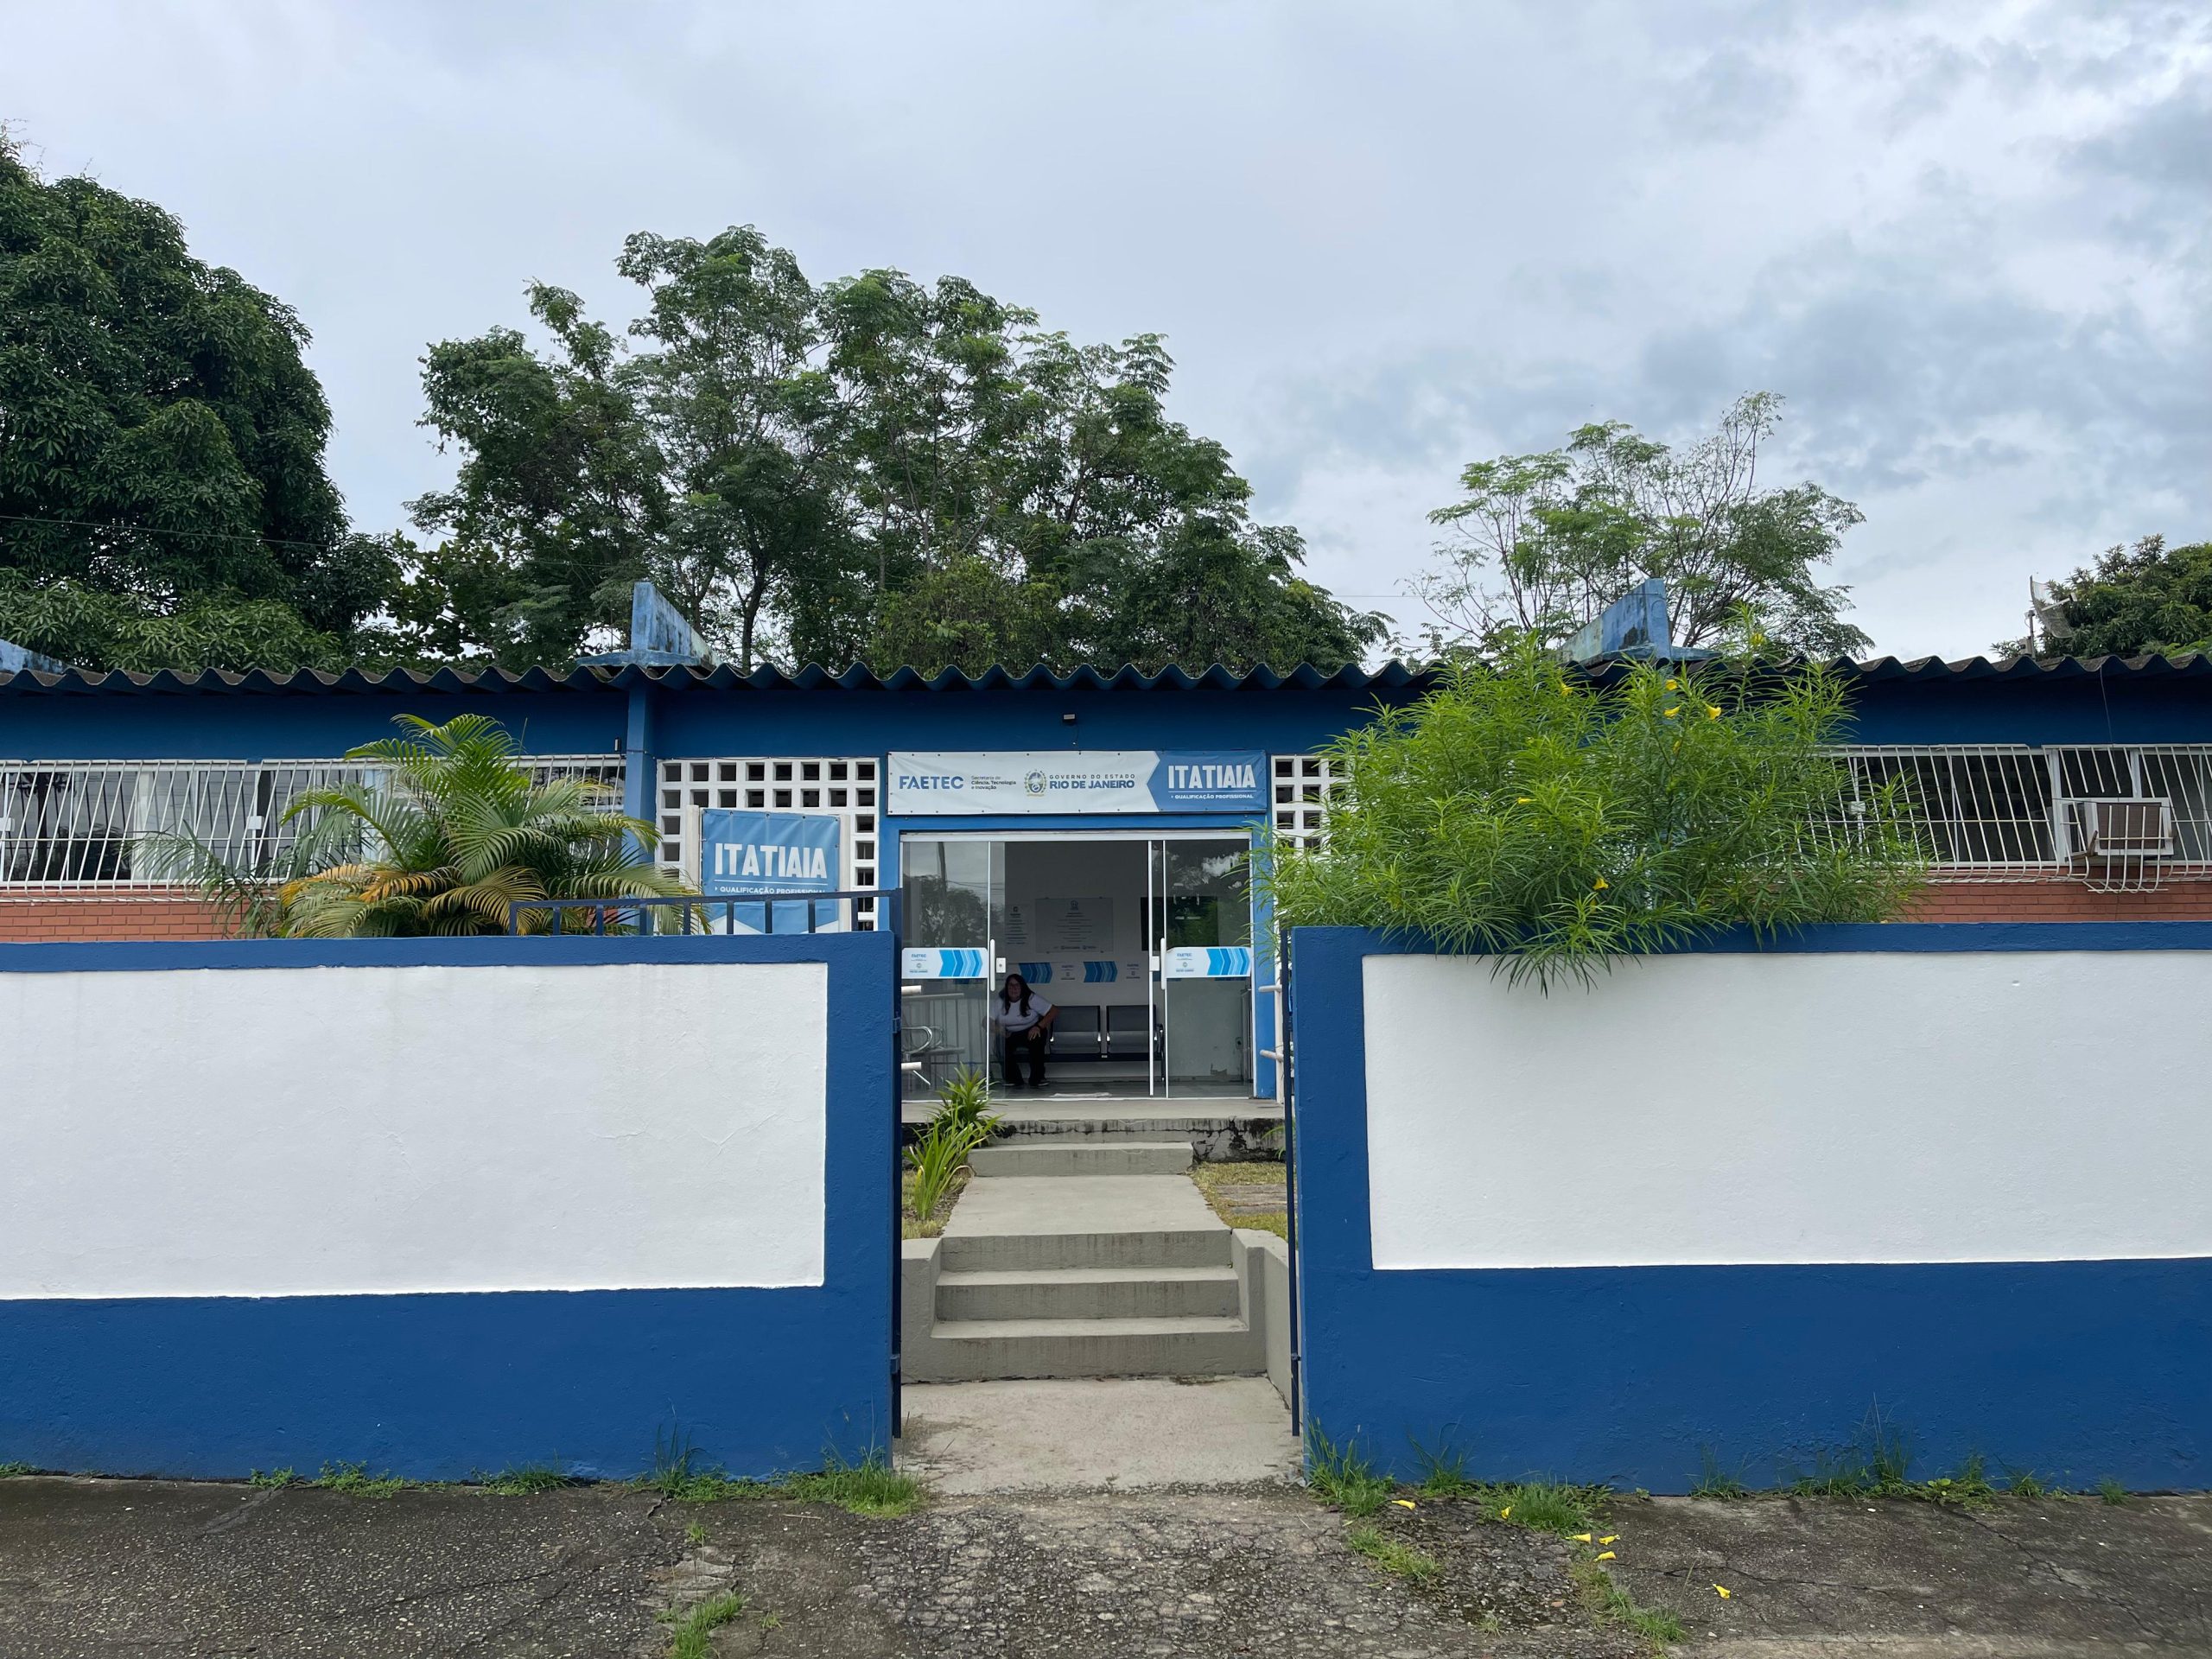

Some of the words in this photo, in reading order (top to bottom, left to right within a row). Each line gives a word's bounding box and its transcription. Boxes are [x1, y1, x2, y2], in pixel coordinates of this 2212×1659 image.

[899, 775, 964, 790] FAETEC
[1168, 765, 1256, 788] ITATIAIA
[1049, 780, 1070, 790] RIO
[1071, 780, 1086, 789] DE
[1088, 779, 1135, 789] JANEIRO
[715, 842, 827, 879] ITATIAIA
[720, 886, 775, 895] QUALIFICAÇÃO
